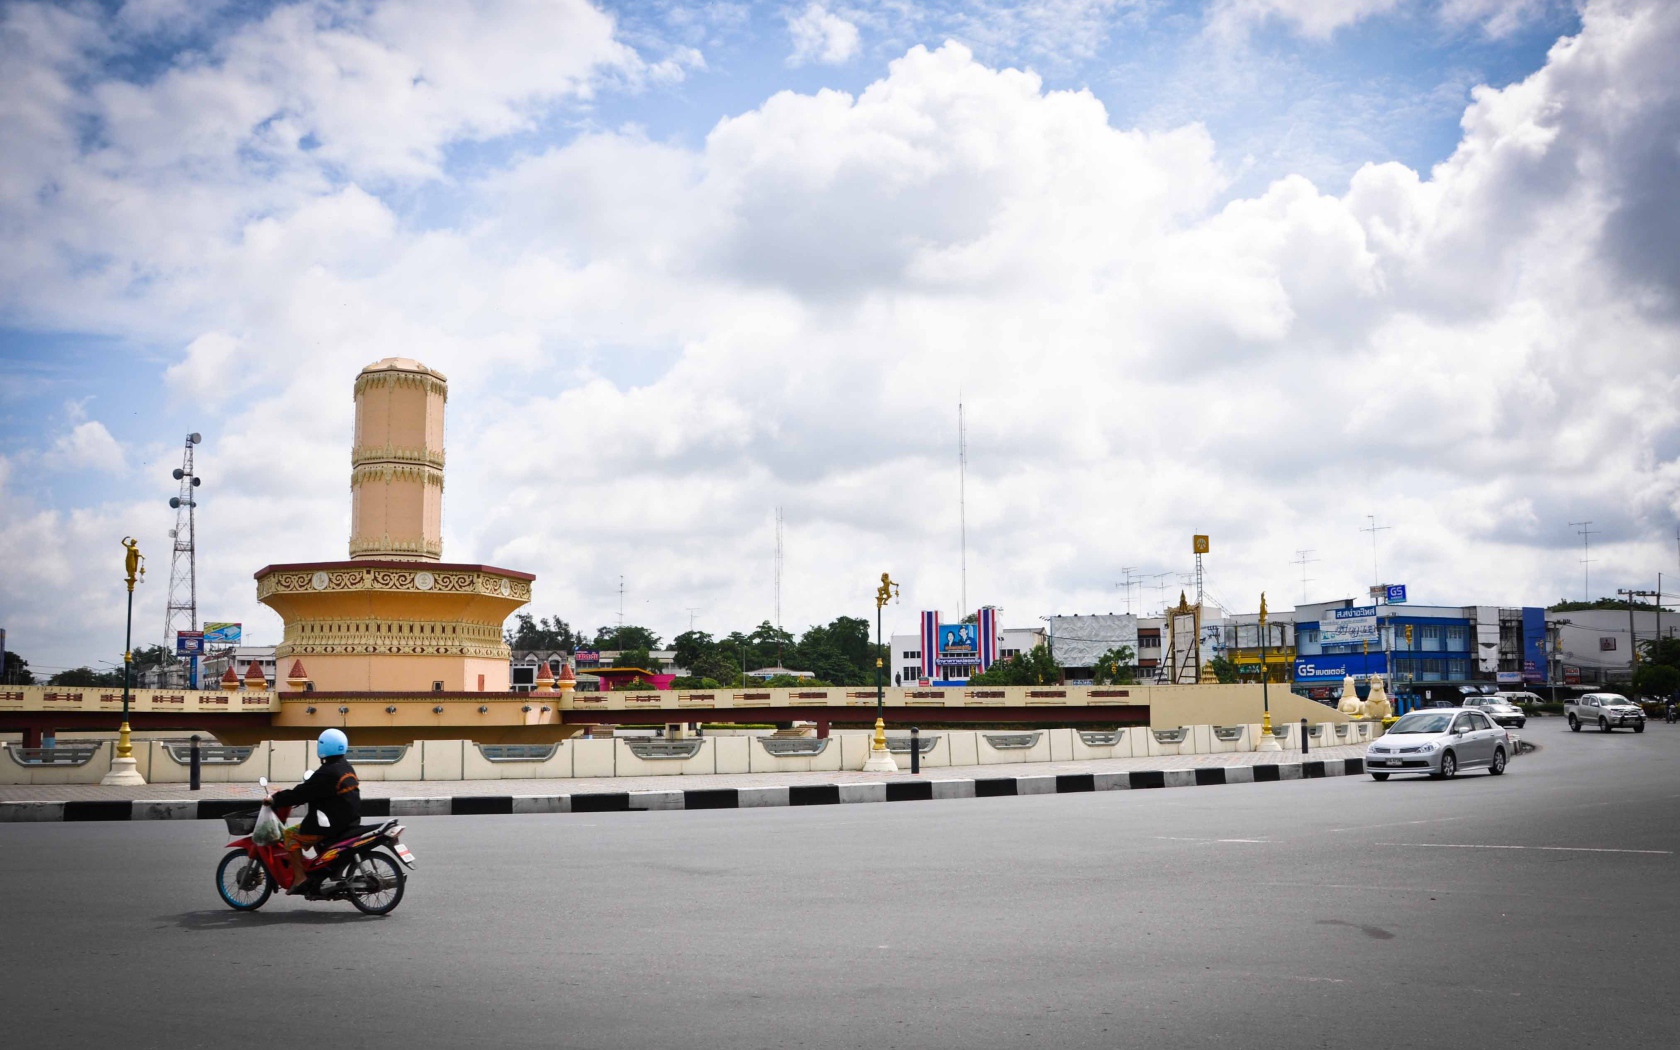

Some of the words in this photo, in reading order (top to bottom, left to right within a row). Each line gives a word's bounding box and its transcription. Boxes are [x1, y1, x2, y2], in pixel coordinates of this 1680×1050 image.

[1390, 587, 1403, 596] GS
[1298, 664, 1315, 676] GS
[1316, 664, 1346, 676] แบตเตอรี่
